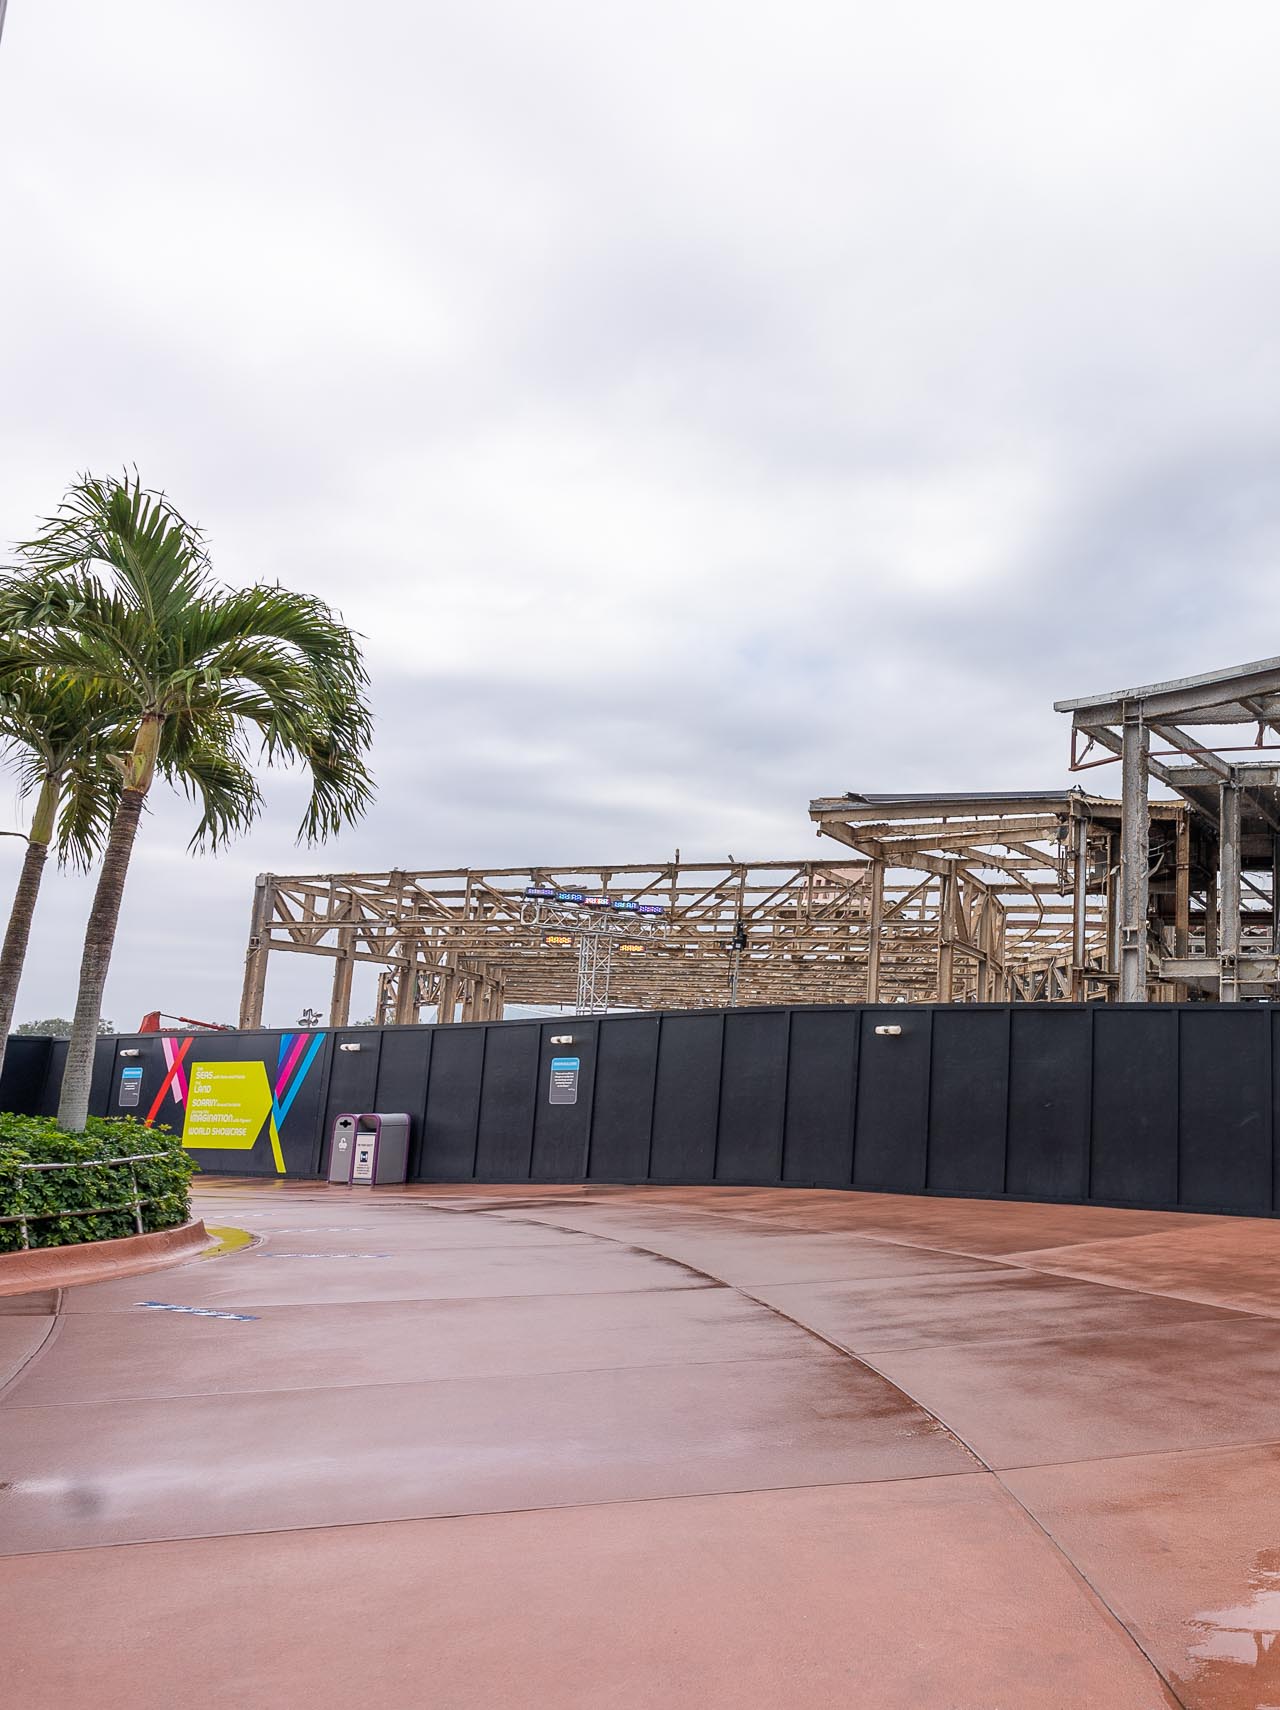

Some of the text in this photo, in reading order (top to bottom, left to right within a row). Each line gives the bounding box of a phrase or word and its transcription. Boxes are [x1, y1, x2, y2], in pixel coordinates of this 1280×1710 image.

[196, 1071, 213, 1079] SEAS
[194, 1085, 212, 1093] LAND
[190, 1113, 233, 1122] IMAGINATION
[188, 1127, 247, 1136] WORLD SHOWCASE
